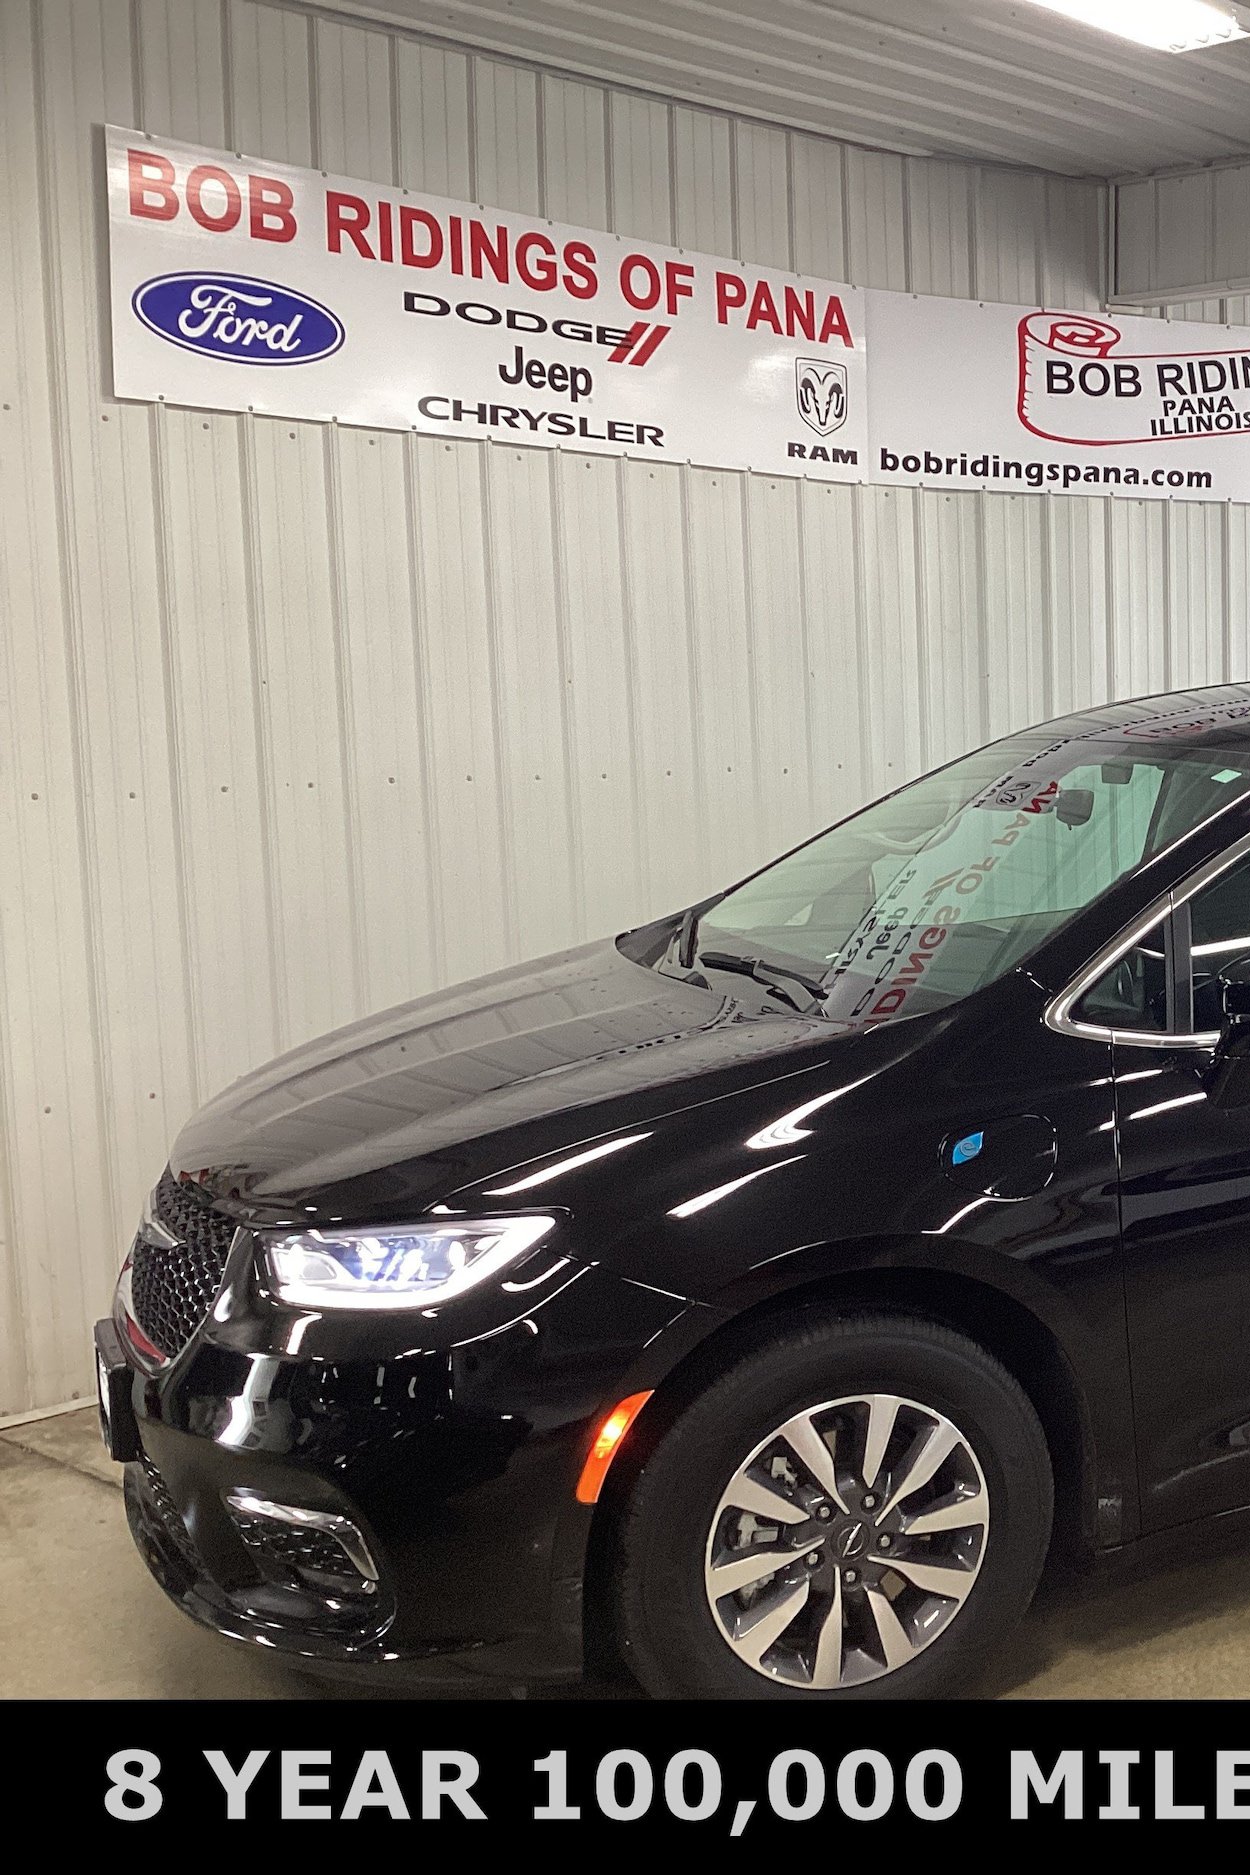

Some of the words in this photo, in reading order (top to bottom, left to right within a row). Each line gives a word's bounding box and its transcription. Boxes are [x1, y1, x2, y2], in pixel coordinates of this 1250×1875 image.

[128, 150, 297, 243] BOB
[326, 191, 598, 300] RIDINGS
[619, 254, 695, 312] OF
[715, 272, 854, 348] PANA
[178, 285, 303, 354] Ford
[404, 291, 634, 350] DODGE
[499, 346, 593, 402] Jeep
[1046, 360, 1142, 398] BOB
[418, 396, 665, 448] CHRYSLER
[1162, 396, 1235, 417] PANA
[787, 442, 858, 465] RAM
[880, 447, 1212, 489] bobridingspana.com
